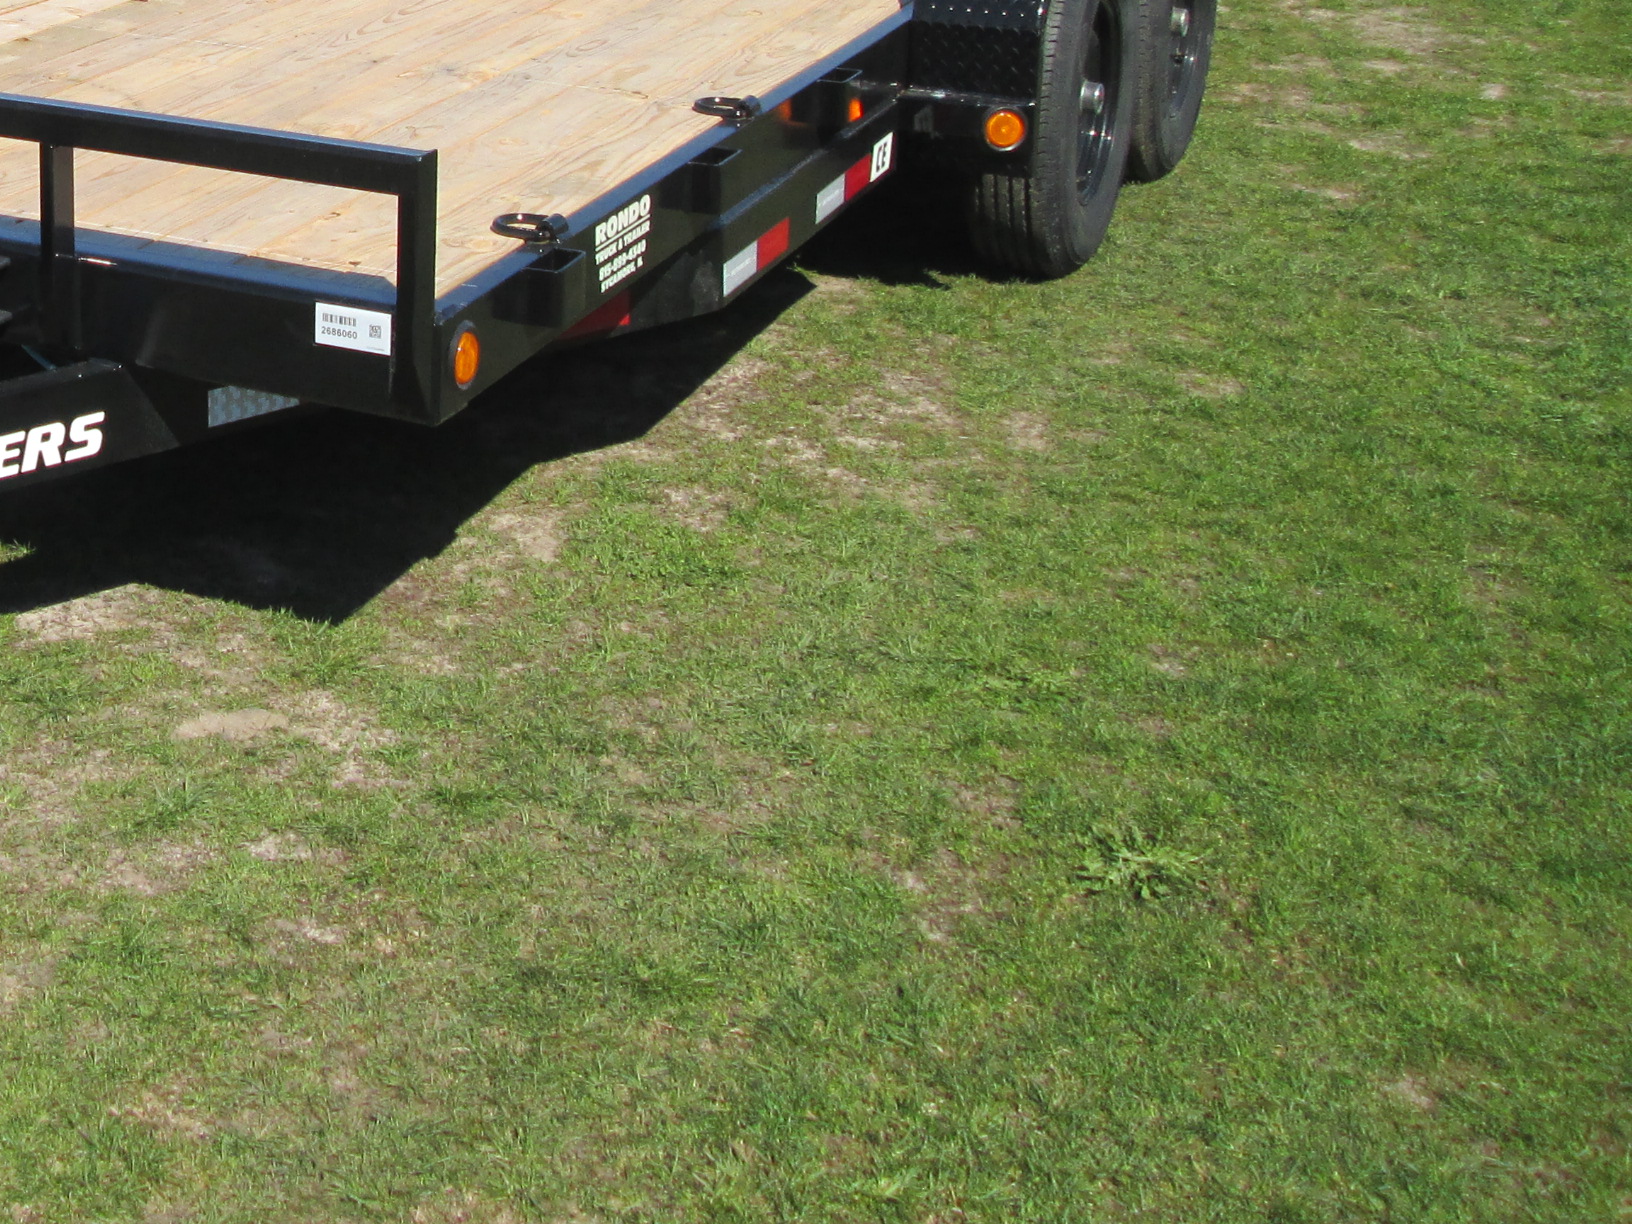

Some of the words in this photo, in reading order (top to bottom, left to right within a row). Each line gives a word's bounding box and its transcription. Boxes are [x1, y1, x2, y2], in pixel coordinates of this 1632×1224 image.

[594, 194, 651, 247] RONDO
[595, 241, 618, 265] TRUCK
[624, 220, 650, 247] TRAILER
[321, 325, 358, 340] 2686060
